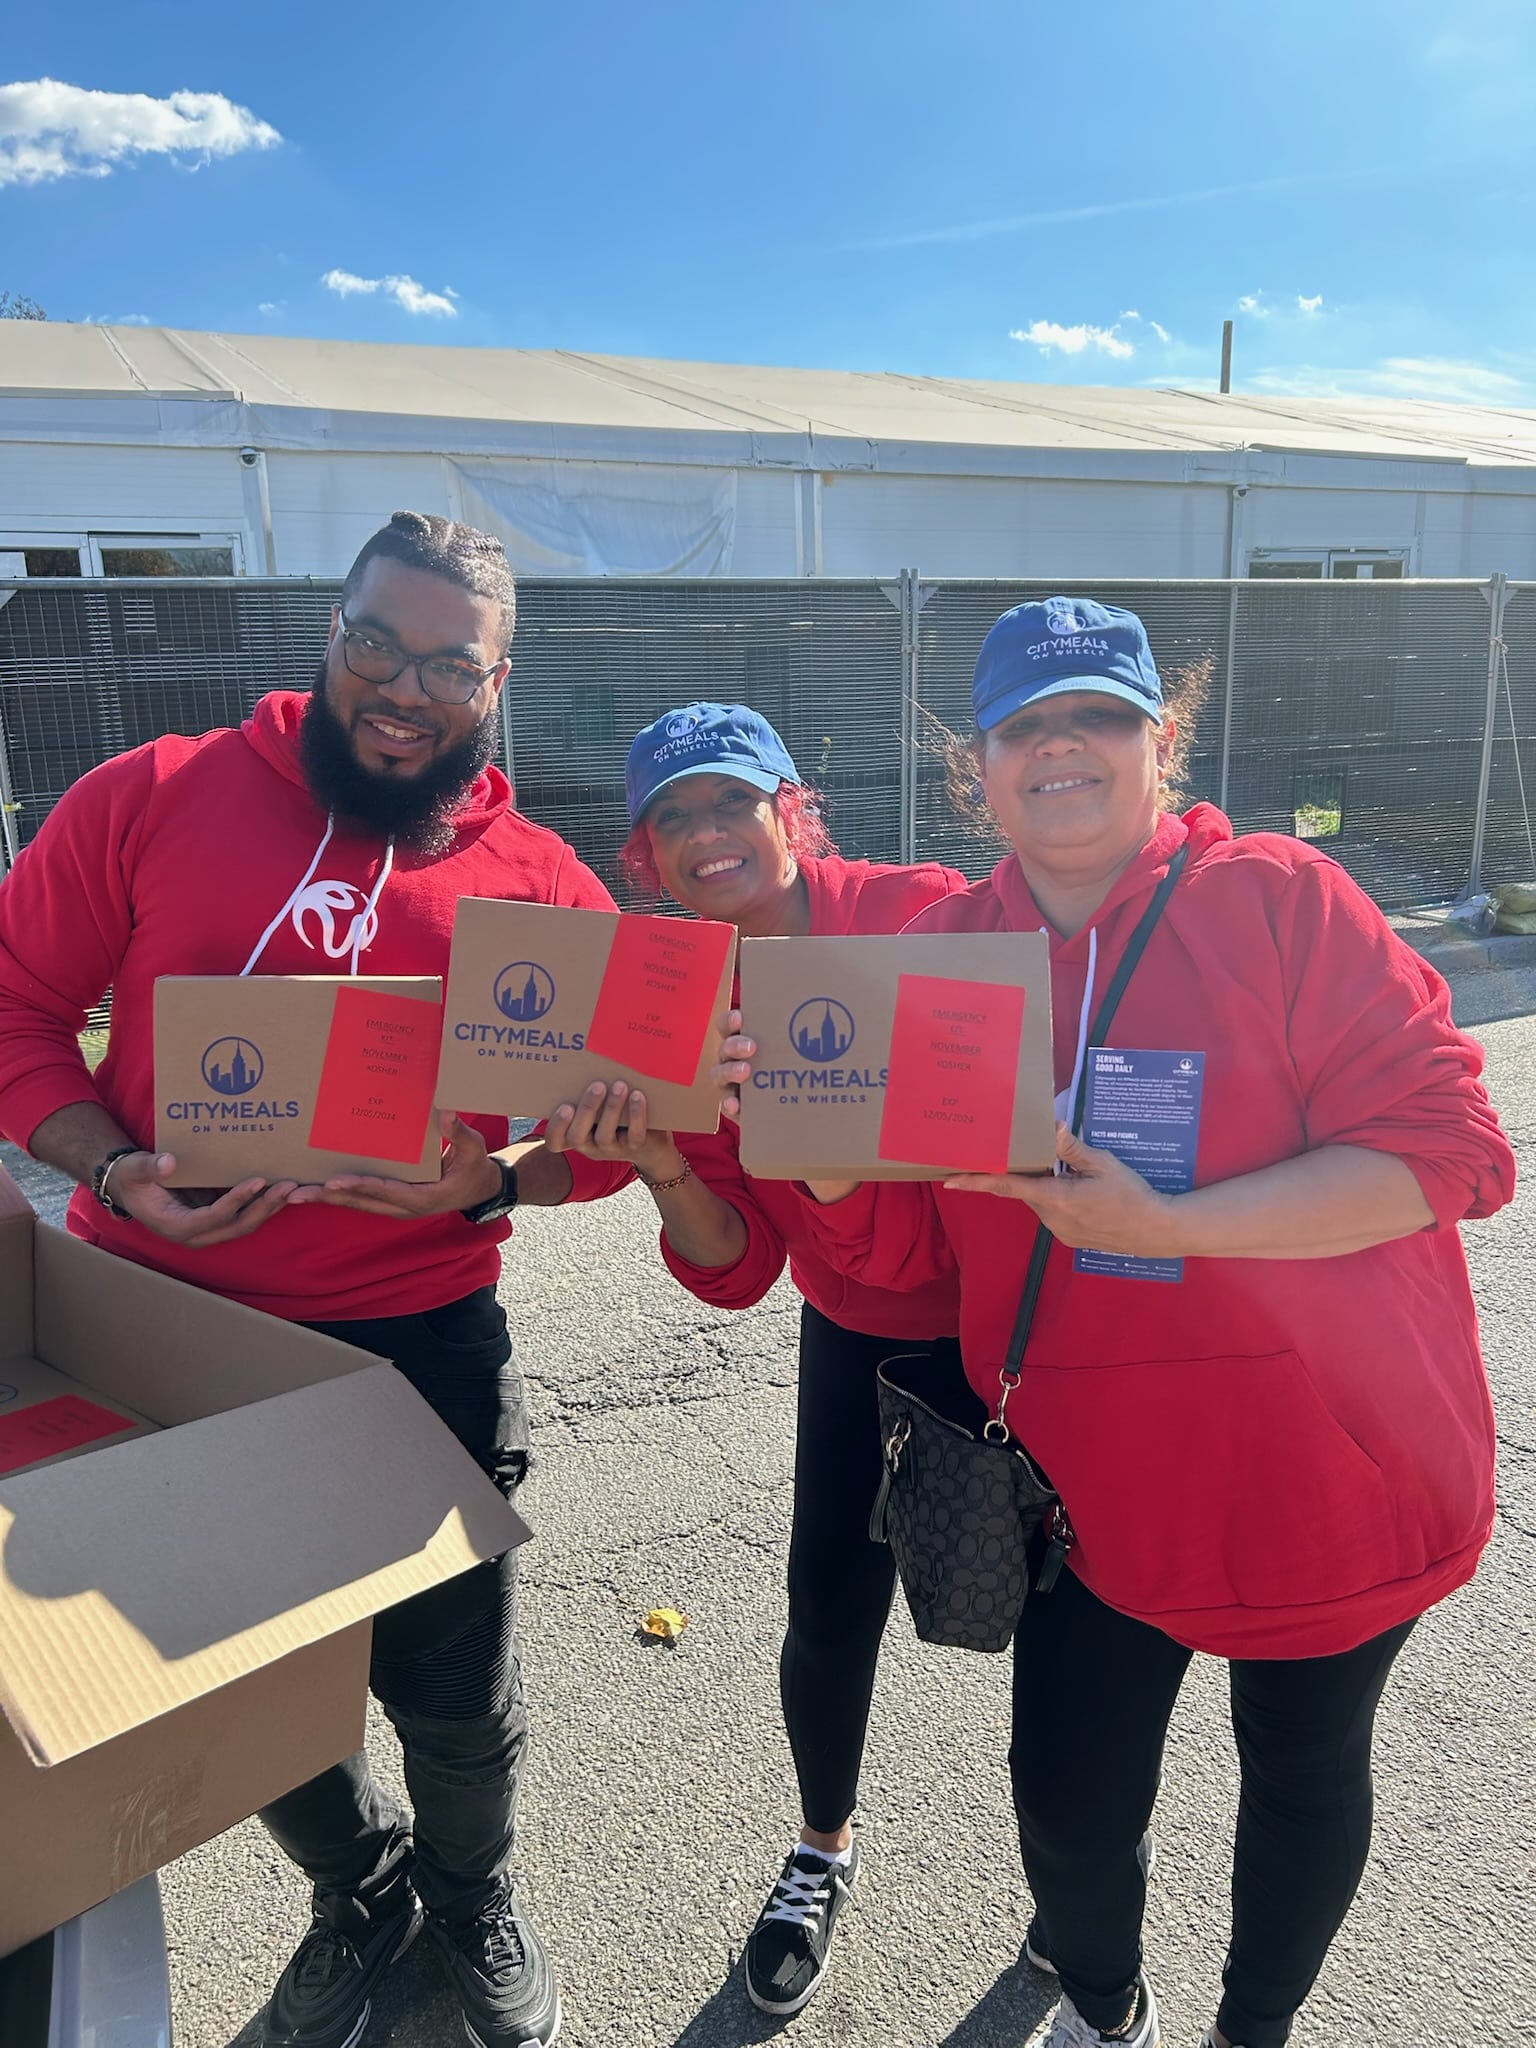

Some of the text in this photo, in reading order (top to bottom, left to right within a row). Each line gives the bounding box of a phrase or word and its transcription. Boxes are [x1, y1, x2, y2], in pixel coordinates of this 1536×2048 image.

[1027, 637, 1109, 656] CITYMEALS
[1032, 649, 1105, 661] ON WHEELS
[653, 731, 720, 760] CITYMEALS
[674, 741, 716, 757] WHEELS
[648, 933, 697, 952] EMERGENCY
[642, 961, 688, 980] NOVEMBER
[645, 979, 678, 992] KOSHER
[645, 1013, 661, 1023] EXP
[931, 1008, 987, 1024] EMERGENCY
[365, 1019, 416, 1034] EMERGENCY
[381, 1034, 394, 1043] KIT
[454, 1023, 584, 1050] CITYMEALS
[930, 1040, 982, 1056] NOVEMBER
[362, 1048, 409, 1063] NOVEMBER
[477, 1048, 559, 1063] ON WHEELS
[1095, 1054, 1124, 1064] SERVING
[366, 1064, 398, 1076] KOSHER
[936, 1060, 972, 1071] KOSHER
[1095, 1063, 1134, 1073] GOOD DAILY
[368, 1096, 384, 1105] EXP
[779, 1094, 867, 1104] ON WHEELS
[941, 1097, 958, 1106] EXP
[166, 1101, 299, 1120] CITYMEALS
[923, 1110, 975, 1124] 12/05/2024
[192, 1123, 275, 1133] ON WHEELS
[1091, 1130, 1106, 1138] FACTS
[1117, 1132, 1138, 1140] FIGURES
